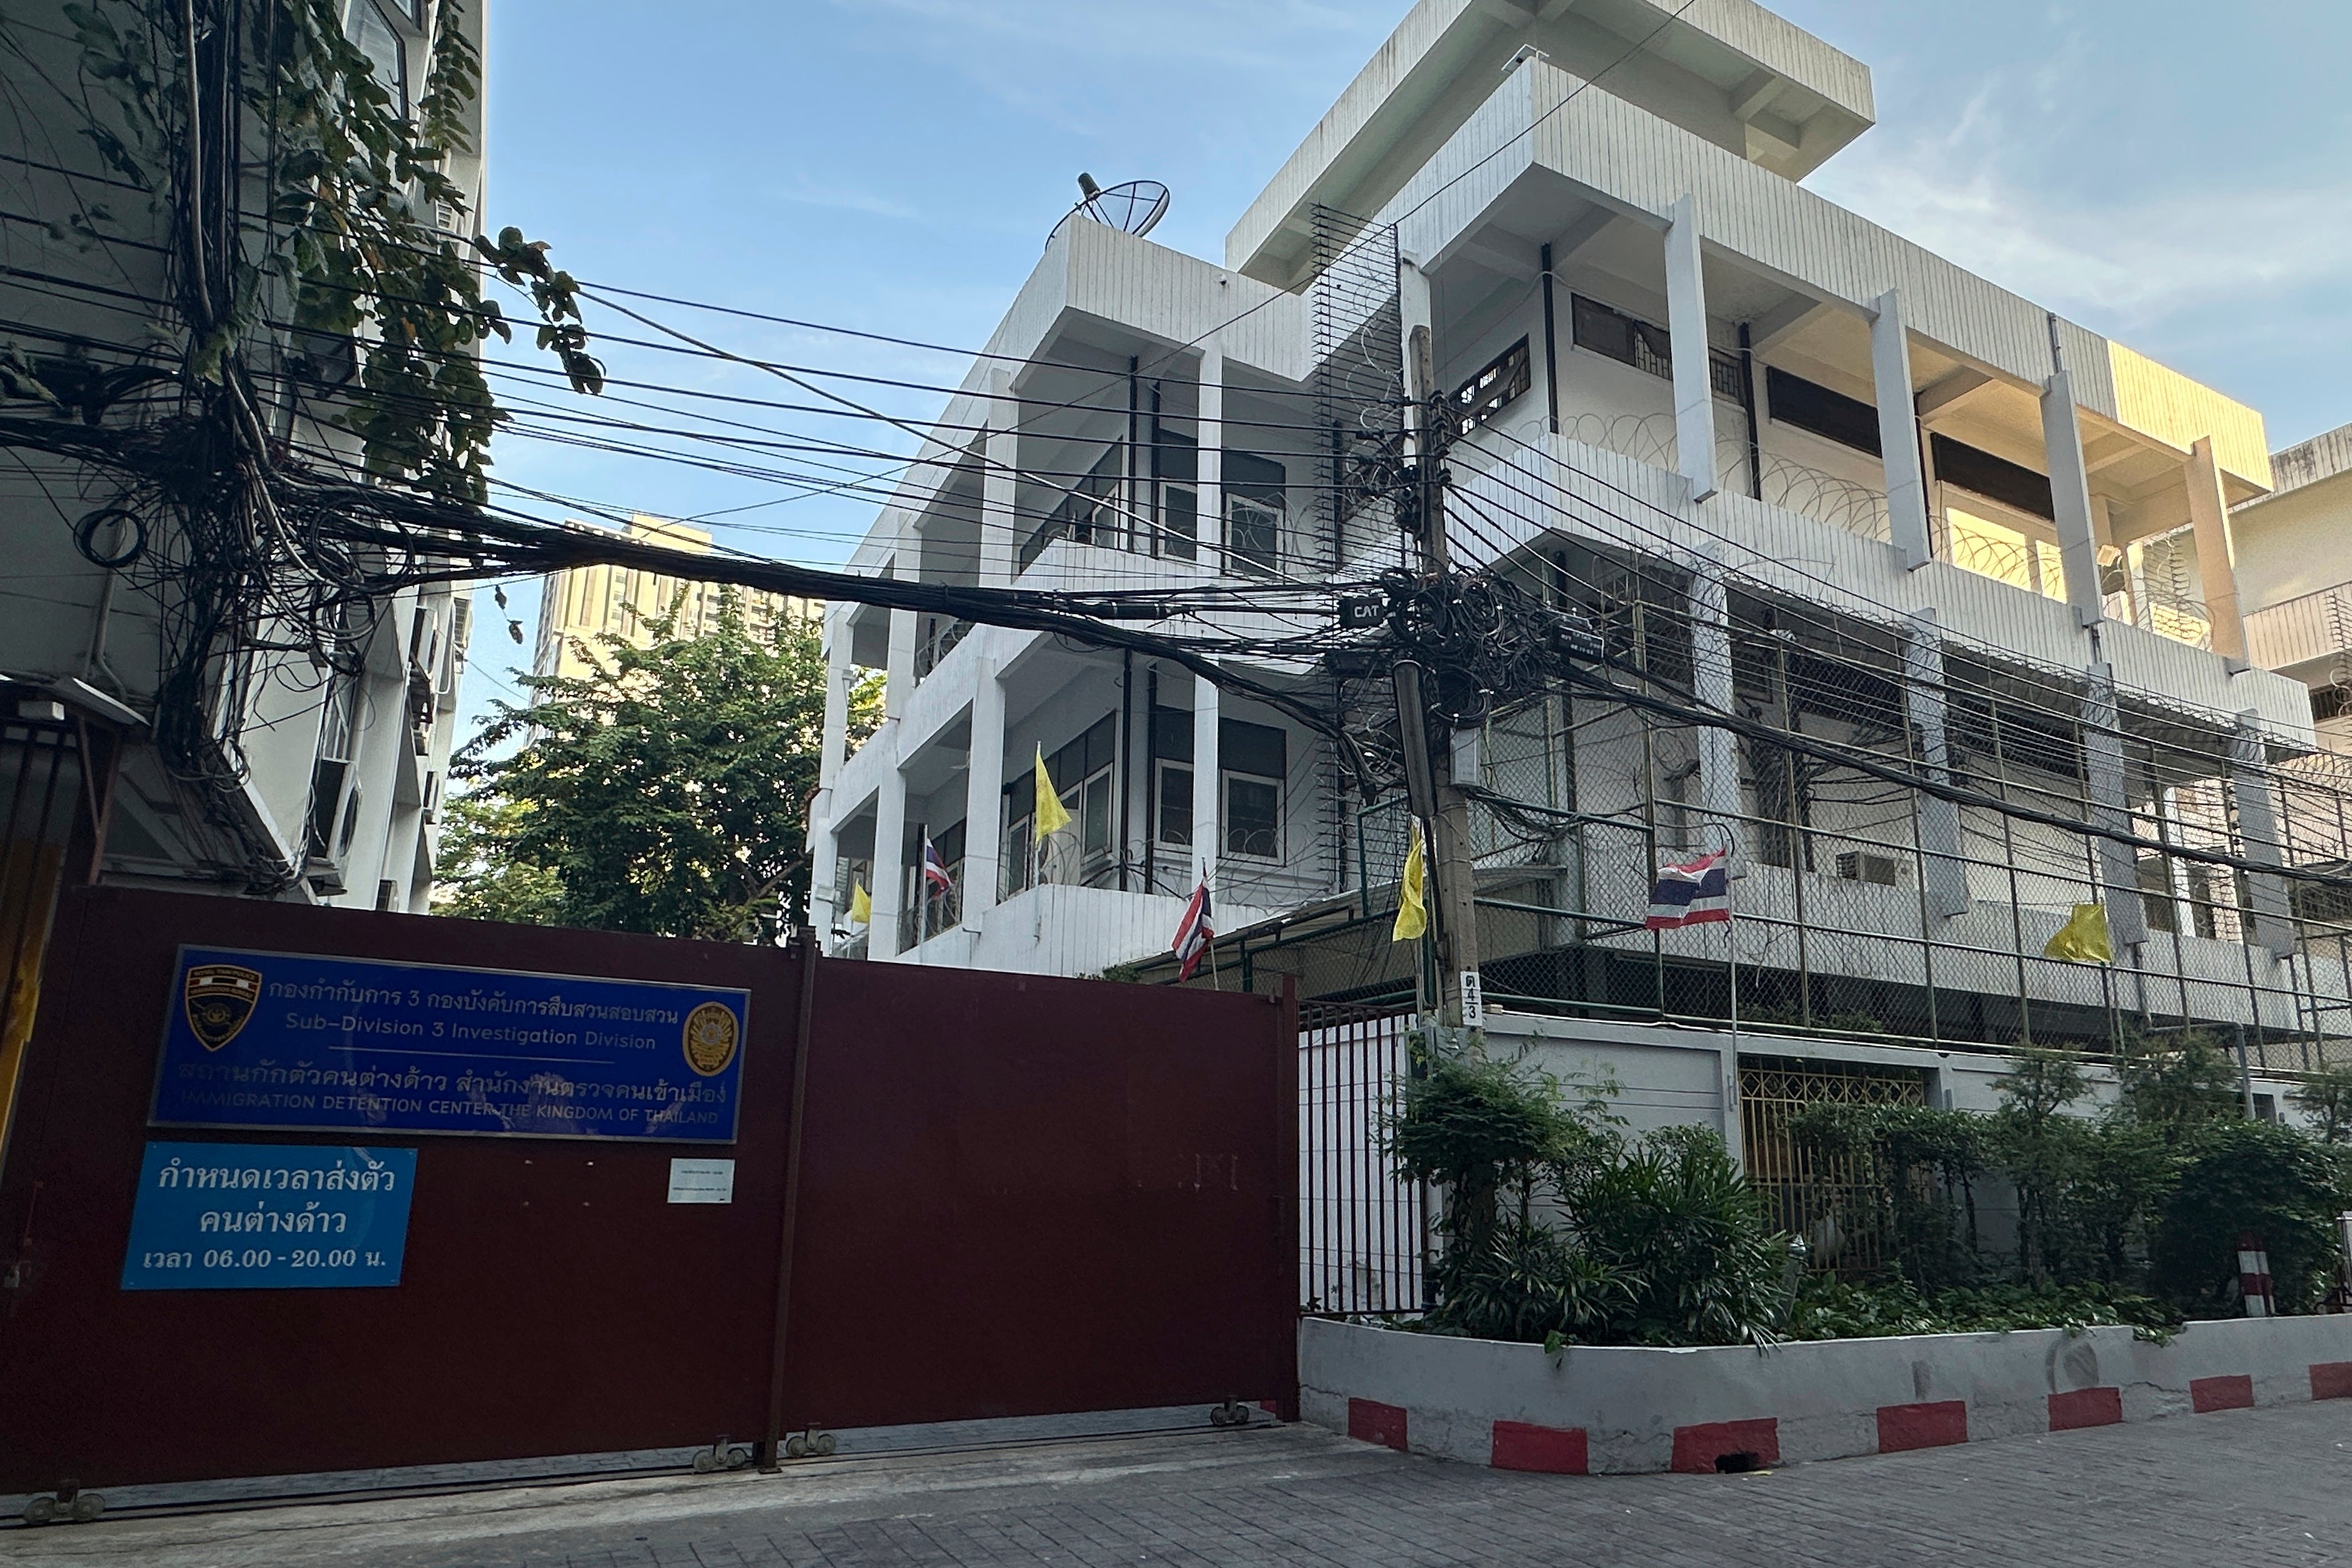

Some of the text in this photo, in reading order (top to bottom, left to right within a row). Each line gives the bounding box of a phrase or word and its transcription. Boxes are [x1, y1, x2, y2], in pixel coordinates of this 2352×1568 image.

[1354, 604, 1379, 618] CAT
[269, 977, 402, 1006] กองกำกับการ
[407, 990, 420, 1006] 3
[427, 989, 679, 1025] กองบังคับการสืบสวนสอบสวน
[1467, 987, 1475, 1001] 4
[1468, 1006, 1476, 1018] 3
[285, 1012, 656, 1050] Sub-Division 3 Investigation Division
[322, 1095, 422, 1112] DETENTION
[536, 1105, 612, 1120] KINGDOM
[619, 1108, 639, 1121] OF
[644, 1109, 719, 1124] THAILAND
[158, 1156, 396, 1191] กำหนดเวลาส่งตัว
[200, 1200, 347, 1233] คนต่างด้าว
[142, 1251, 192, 1268] เวลา
[203, 1249, 272, 1268] 06.00
[291, 1249, 356, 1268] 20.00
[365, 1252, 387, 1268] น.
